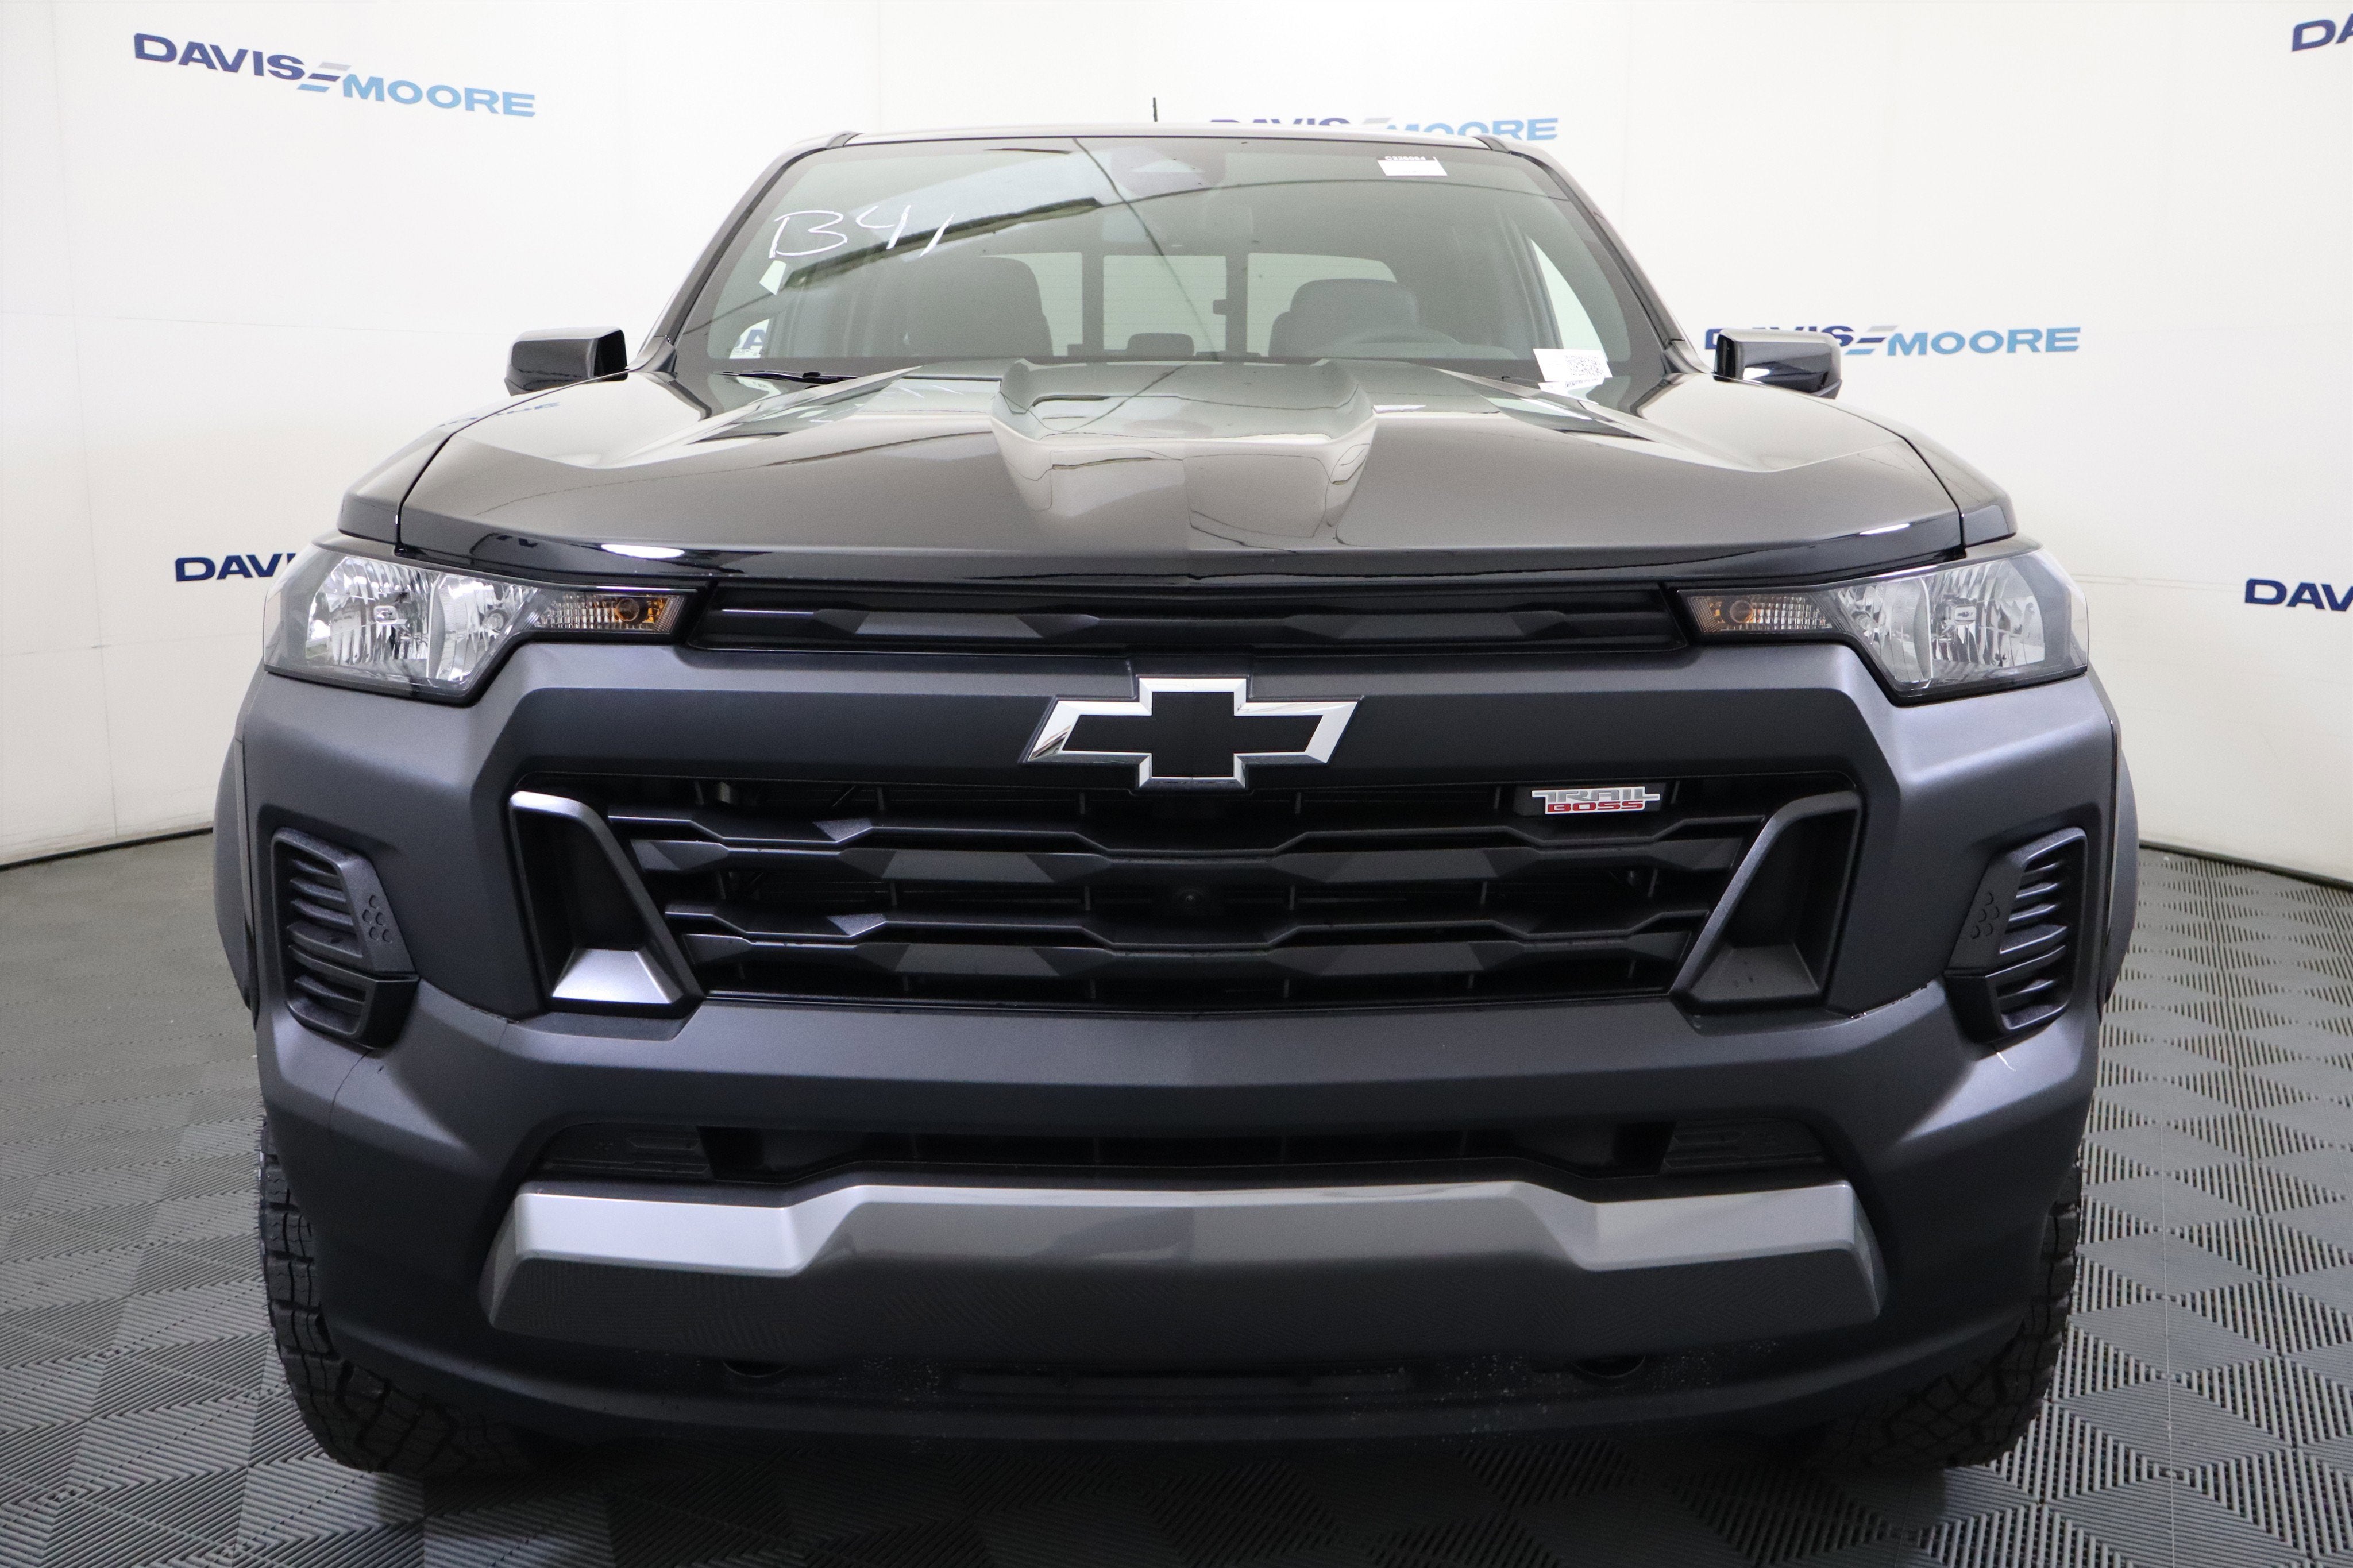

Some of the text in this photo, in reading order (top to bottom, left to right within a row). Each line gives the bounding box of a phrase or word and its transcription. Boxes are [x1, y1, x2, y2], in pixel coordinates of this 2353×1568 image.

[134, 33, 535, 117] DAVIS MOORE
[1887, 327, 2081, 356] MOORE
[1532, 787, 1660, 804] TRAIL
[1546, 800, 1645, 813] BOSS
